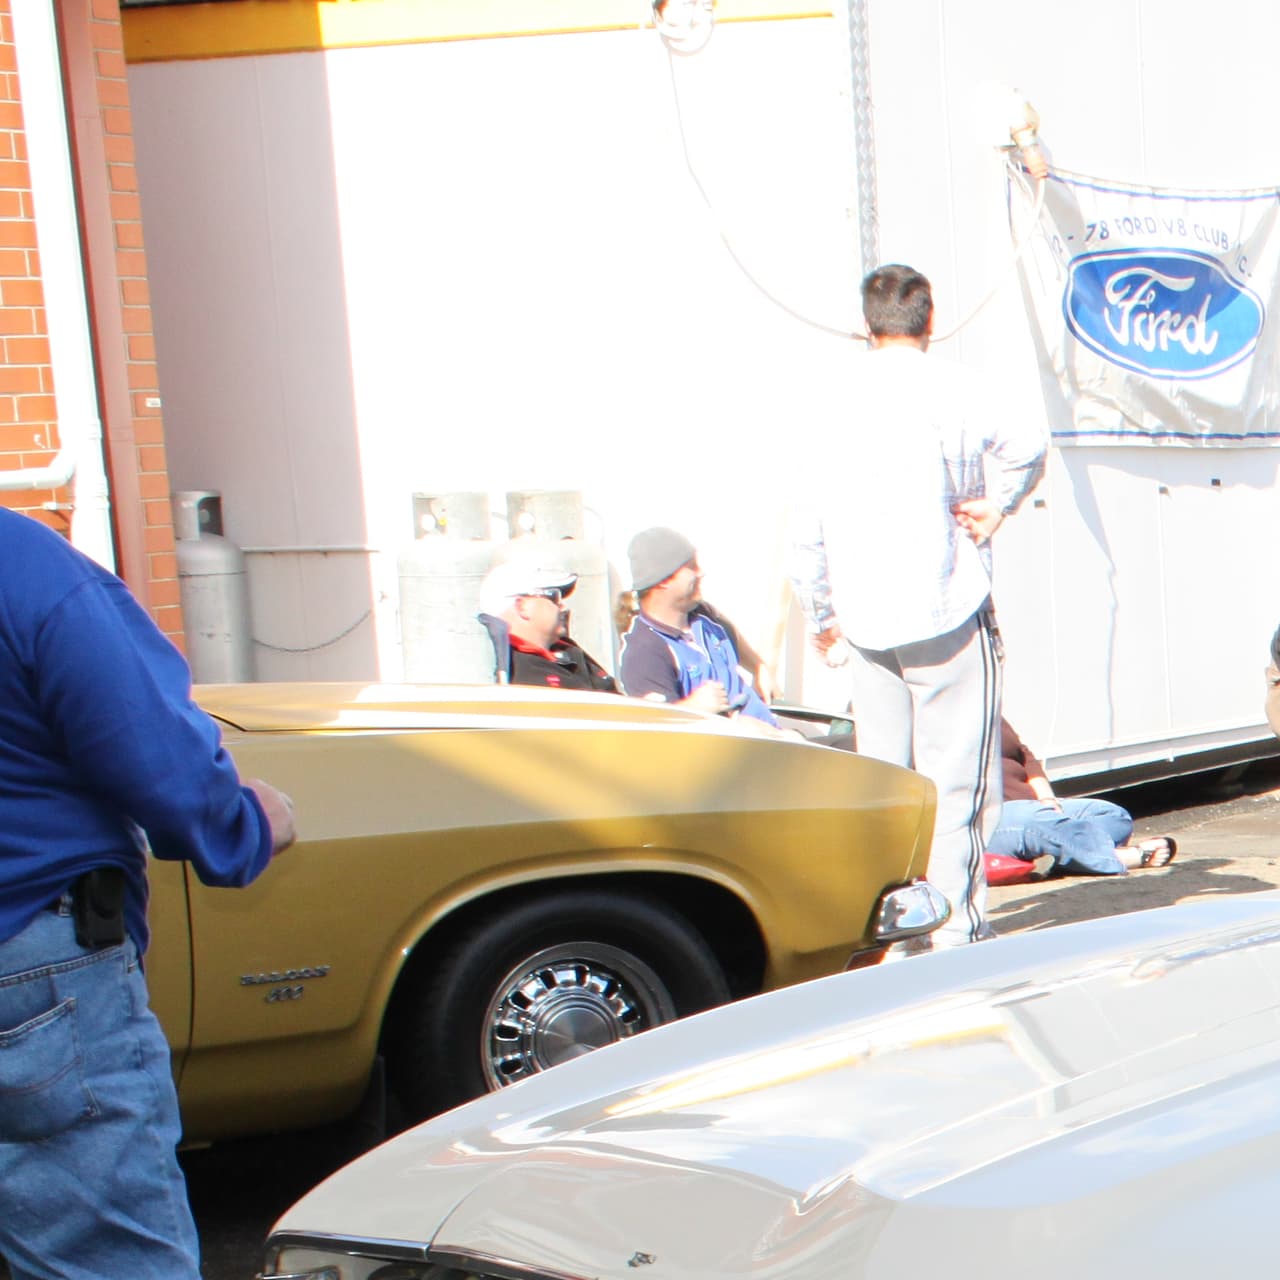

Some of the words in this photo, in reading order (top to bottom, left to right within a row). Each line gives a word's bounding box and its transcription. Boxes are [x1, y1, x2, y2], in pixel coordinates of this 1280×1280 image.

[1084, 220, 1109, 241] 78
[1115, 216, 1157, 237] FORD
[1162, 217, 1188, 237] V8
[1194, 223, 1229, 251] CLUB
[1104, 265, 1219, 355] Ford
